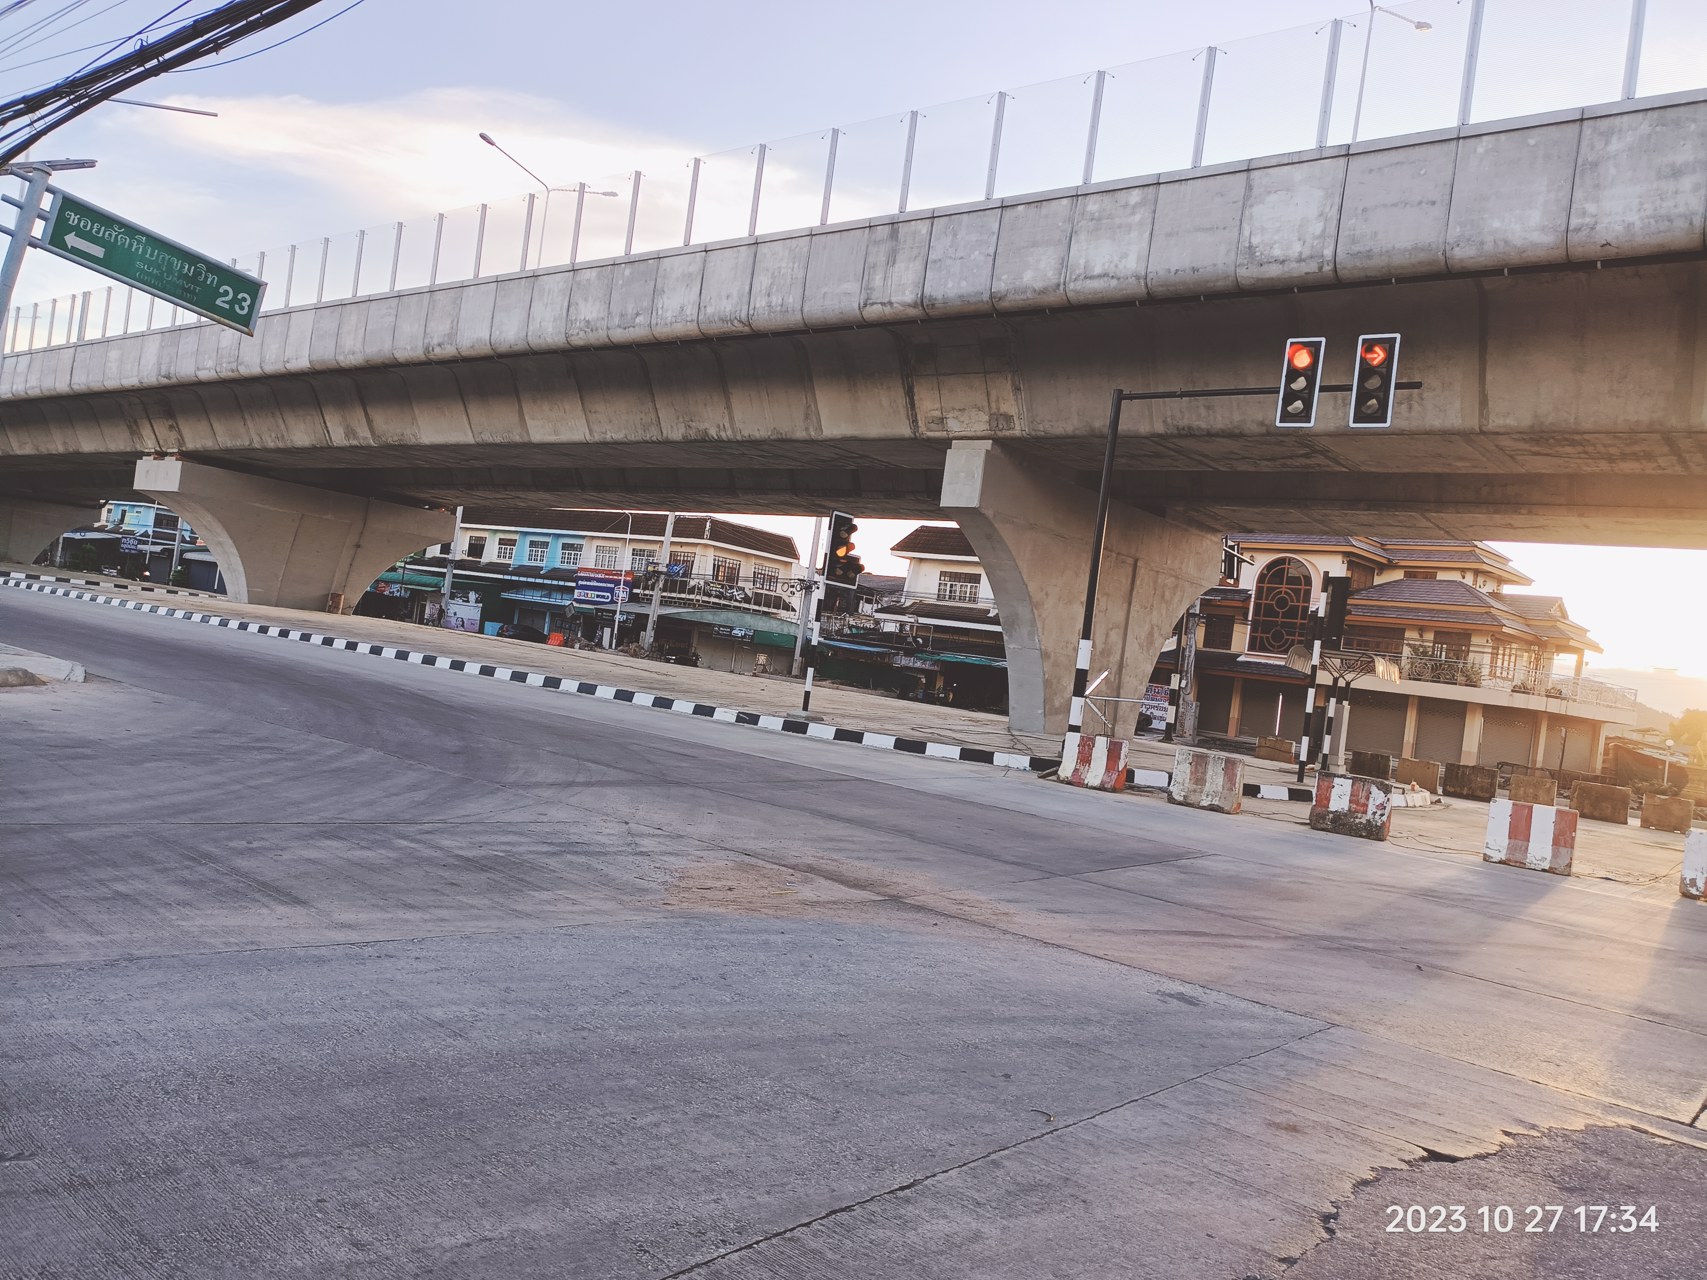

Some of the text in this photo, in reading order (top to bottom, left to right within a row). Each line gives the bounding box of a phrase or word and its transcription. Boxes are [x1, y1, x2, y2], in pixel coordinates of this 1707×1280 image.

[65, 210, 218, 287] ซอยสัตหีบสุขุมวิท
[215, 285, 251, 315] 23
